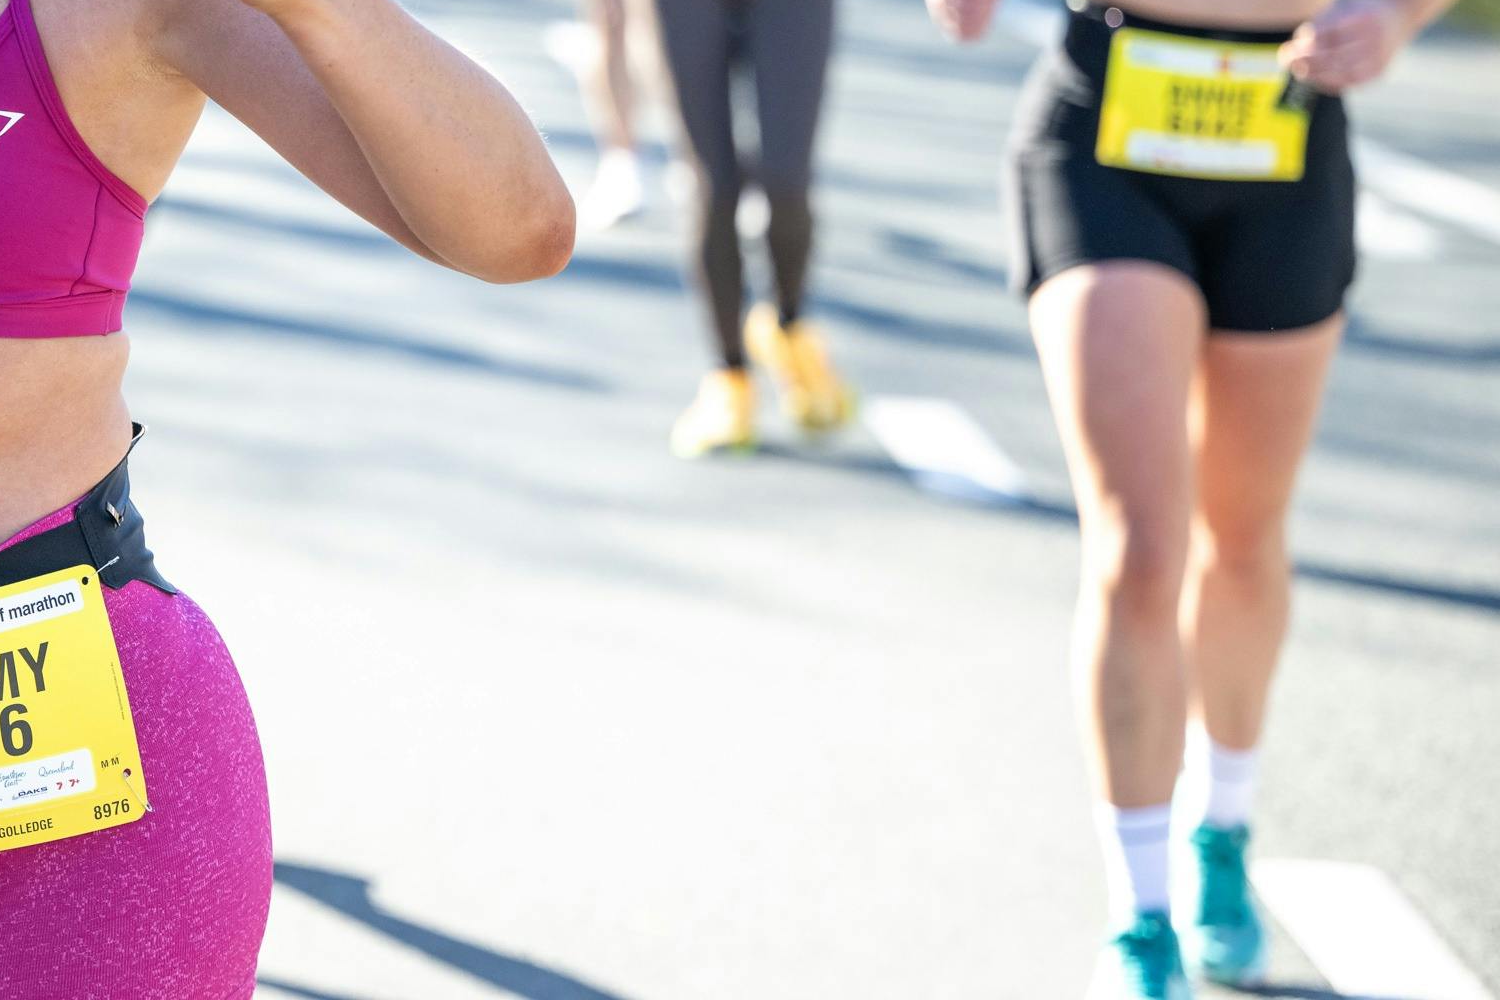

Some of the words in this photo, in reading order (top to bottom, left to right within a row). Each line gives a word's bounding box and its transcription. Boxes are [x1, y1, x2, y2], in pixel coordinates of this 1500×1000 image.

[8, 592, 75, 620] marathon
[18, 786, 48, 797] OAKS
[94, 799, 130, 820] 8976
